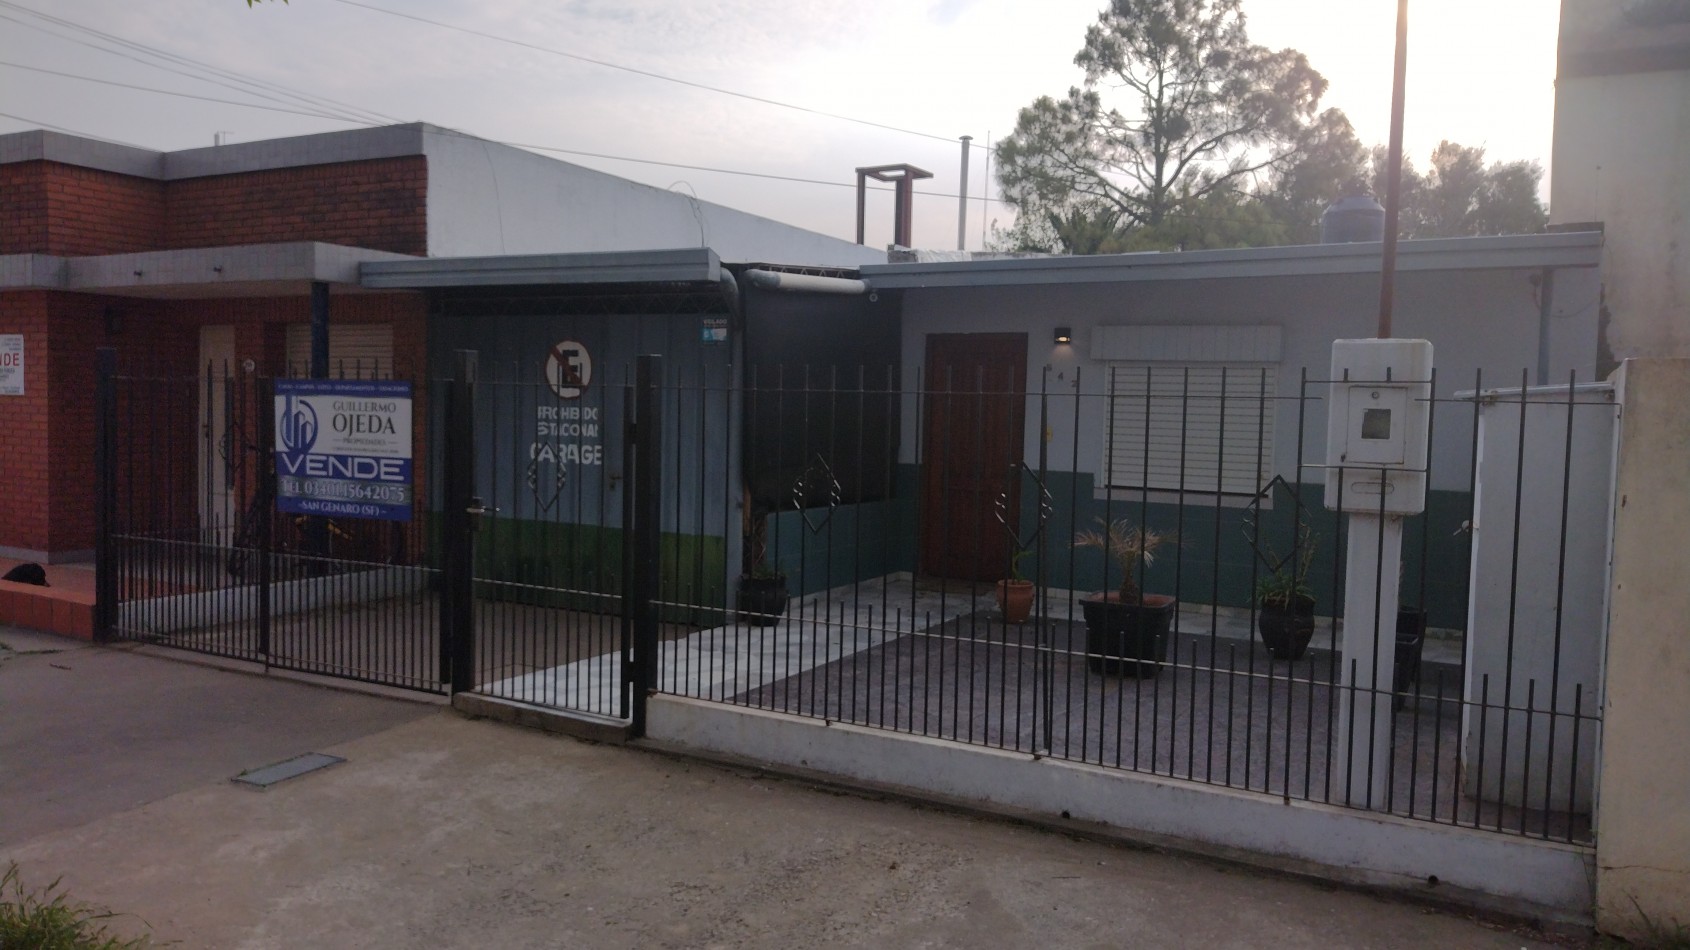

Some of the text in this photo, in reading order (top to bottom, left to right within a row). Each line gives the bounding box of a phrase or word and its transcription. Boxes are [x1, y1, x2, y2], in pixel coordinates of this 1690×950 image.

[333, 401, 396, 413] GUILLERMO
[332, 413, 396, 437] OJEDA
[281, 452, 405, 481] VENDE
[321, 501, 360, 514] GENARO
